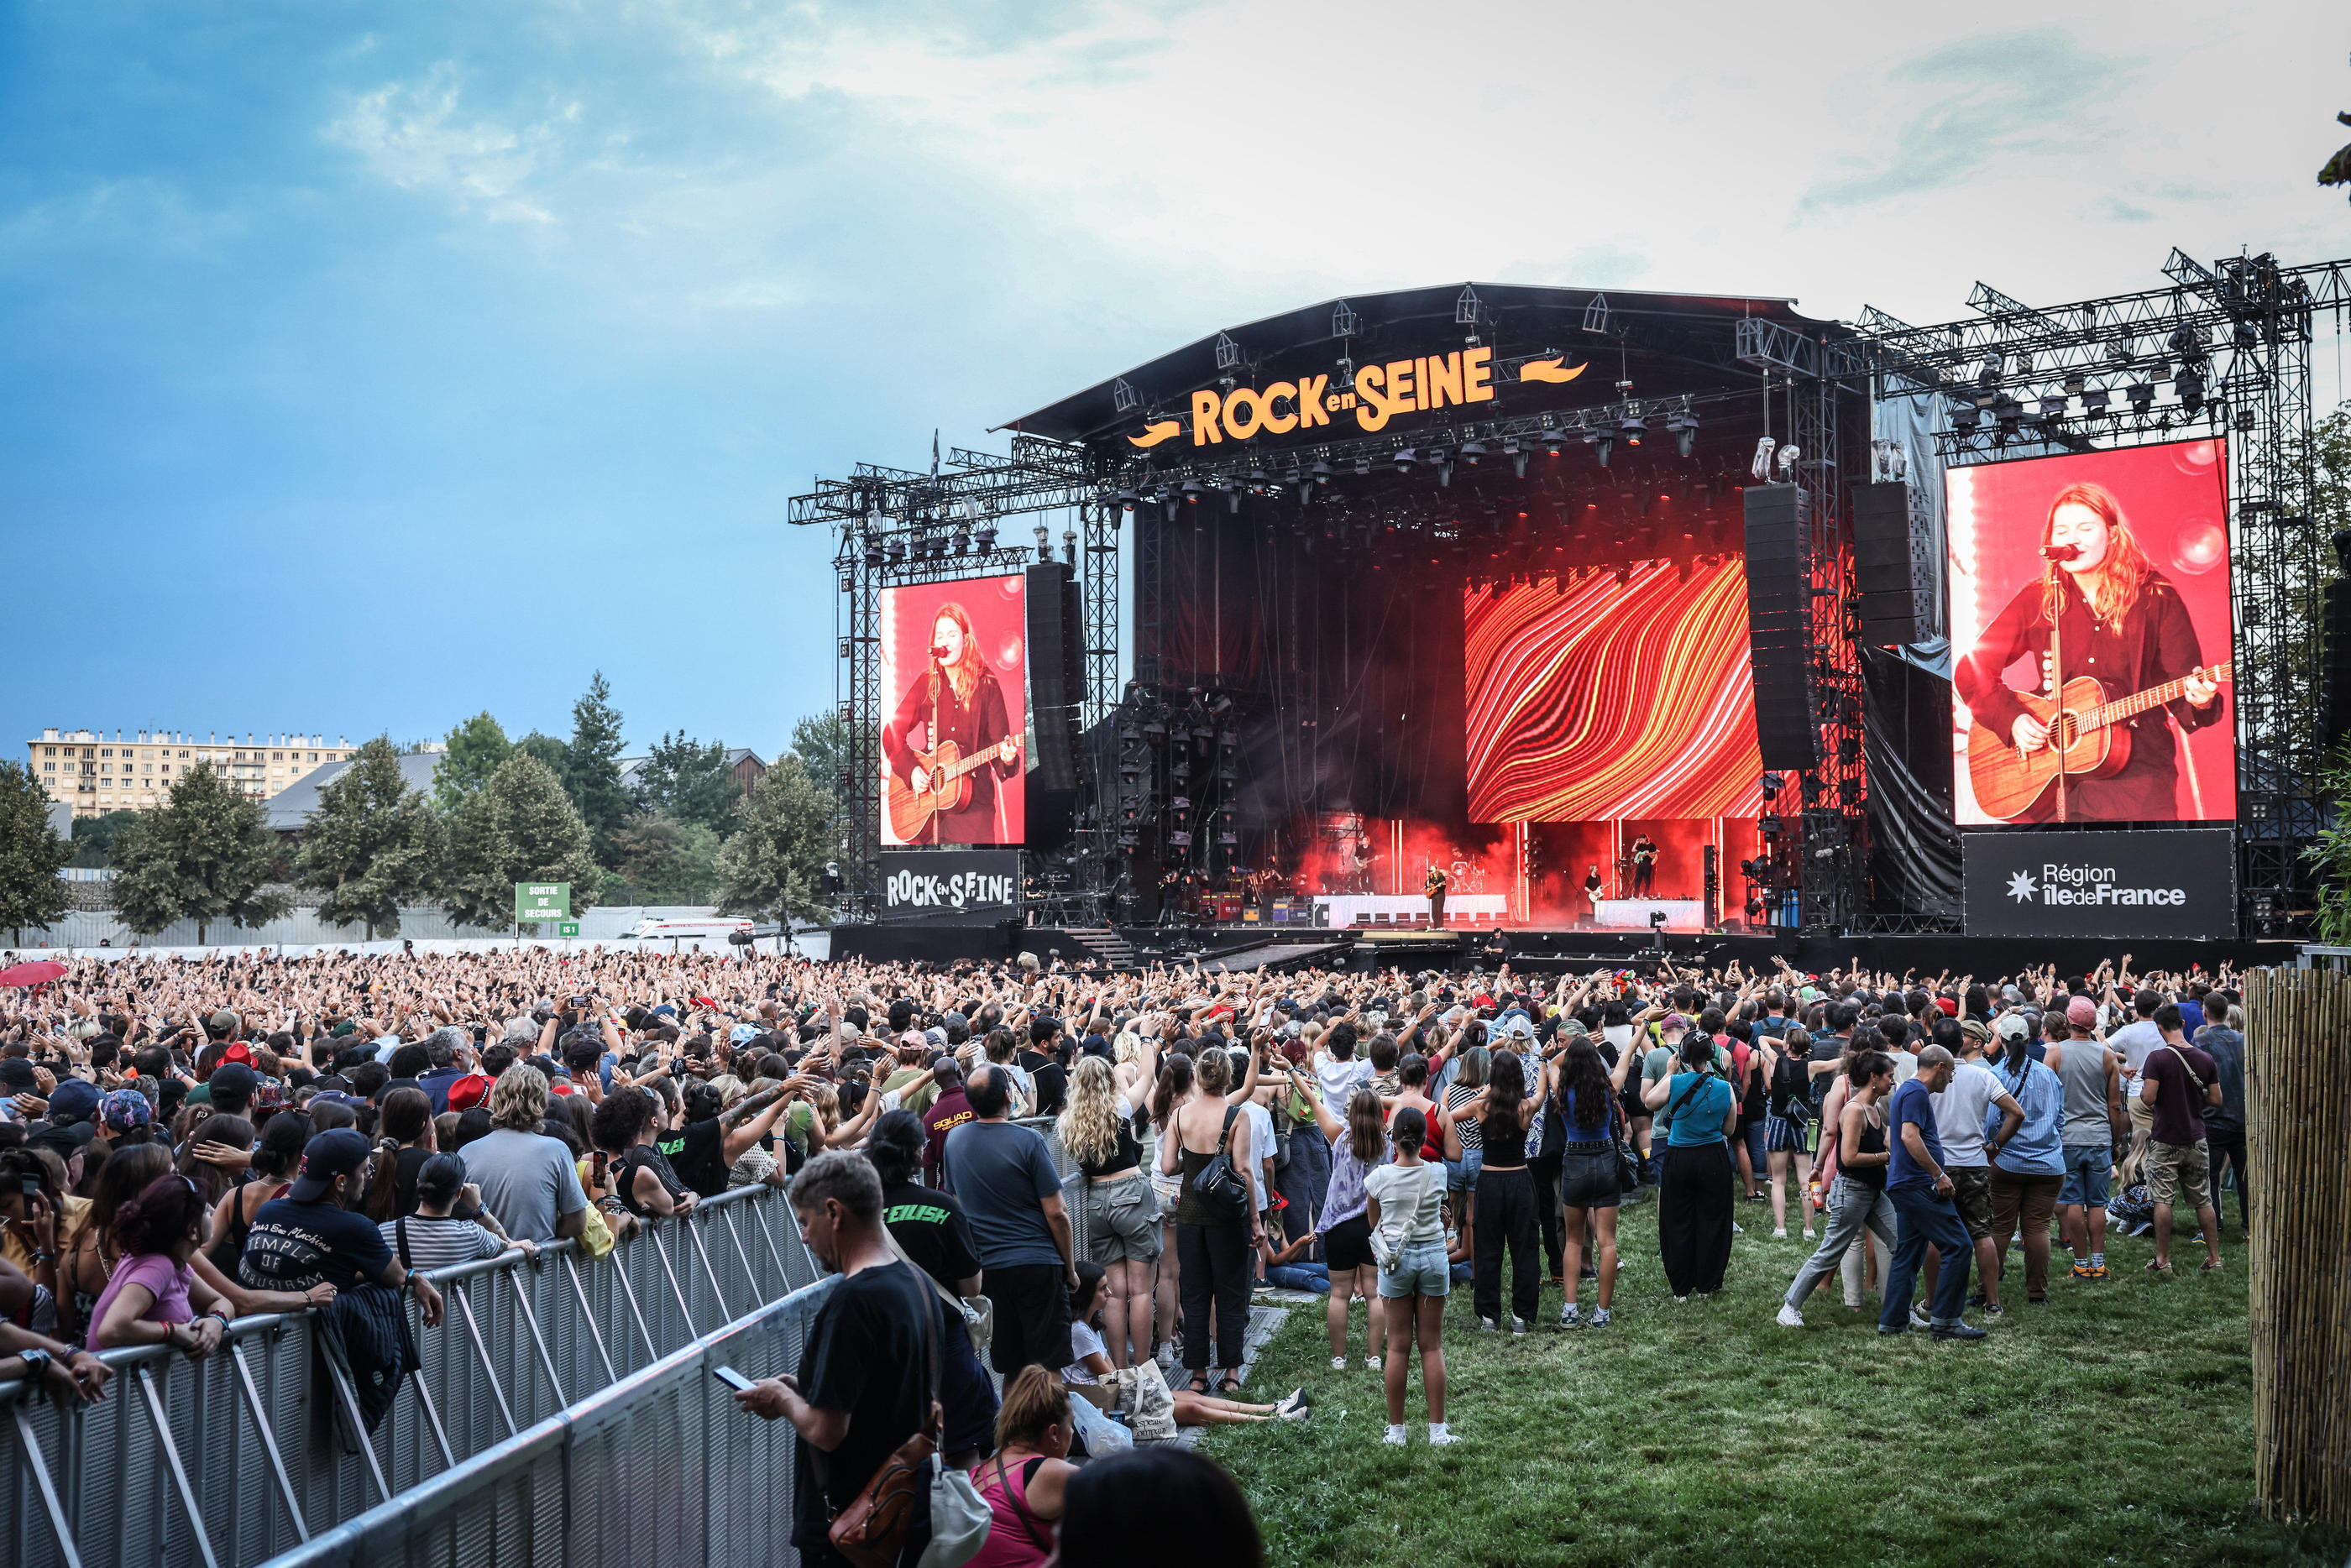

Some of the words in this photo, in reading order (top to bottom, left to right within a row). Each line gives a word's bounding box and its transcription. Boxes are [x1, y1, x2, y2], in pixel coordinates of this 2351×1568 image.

[1192, 374, 1330, 446] ROCK
[1326, 393, 1356, 411] en
[1355, 347, 1494, 432] SEINE
[2043, 863, 2116, 887] Région
[529, 886, 558, 896] SORTIE
[888, 870, 941, 907] ROCK
[937, 883, 950, 896] EN
[950, 870, 1013, 908] SEINE
[537, 898, 549, 907] DE
[525, 909, 563, 918] SECOURS
[933, 1111, 972, 1131] SQUAD
[886, 1204, 951, 1225] EILISH
[249, 1221, 269, 1233] Deus
[287, 1226, 332, 1252] Machina
[248, 1236, 317, 1264] TEMPLE
[261, 1254, 281, 1269] OF
